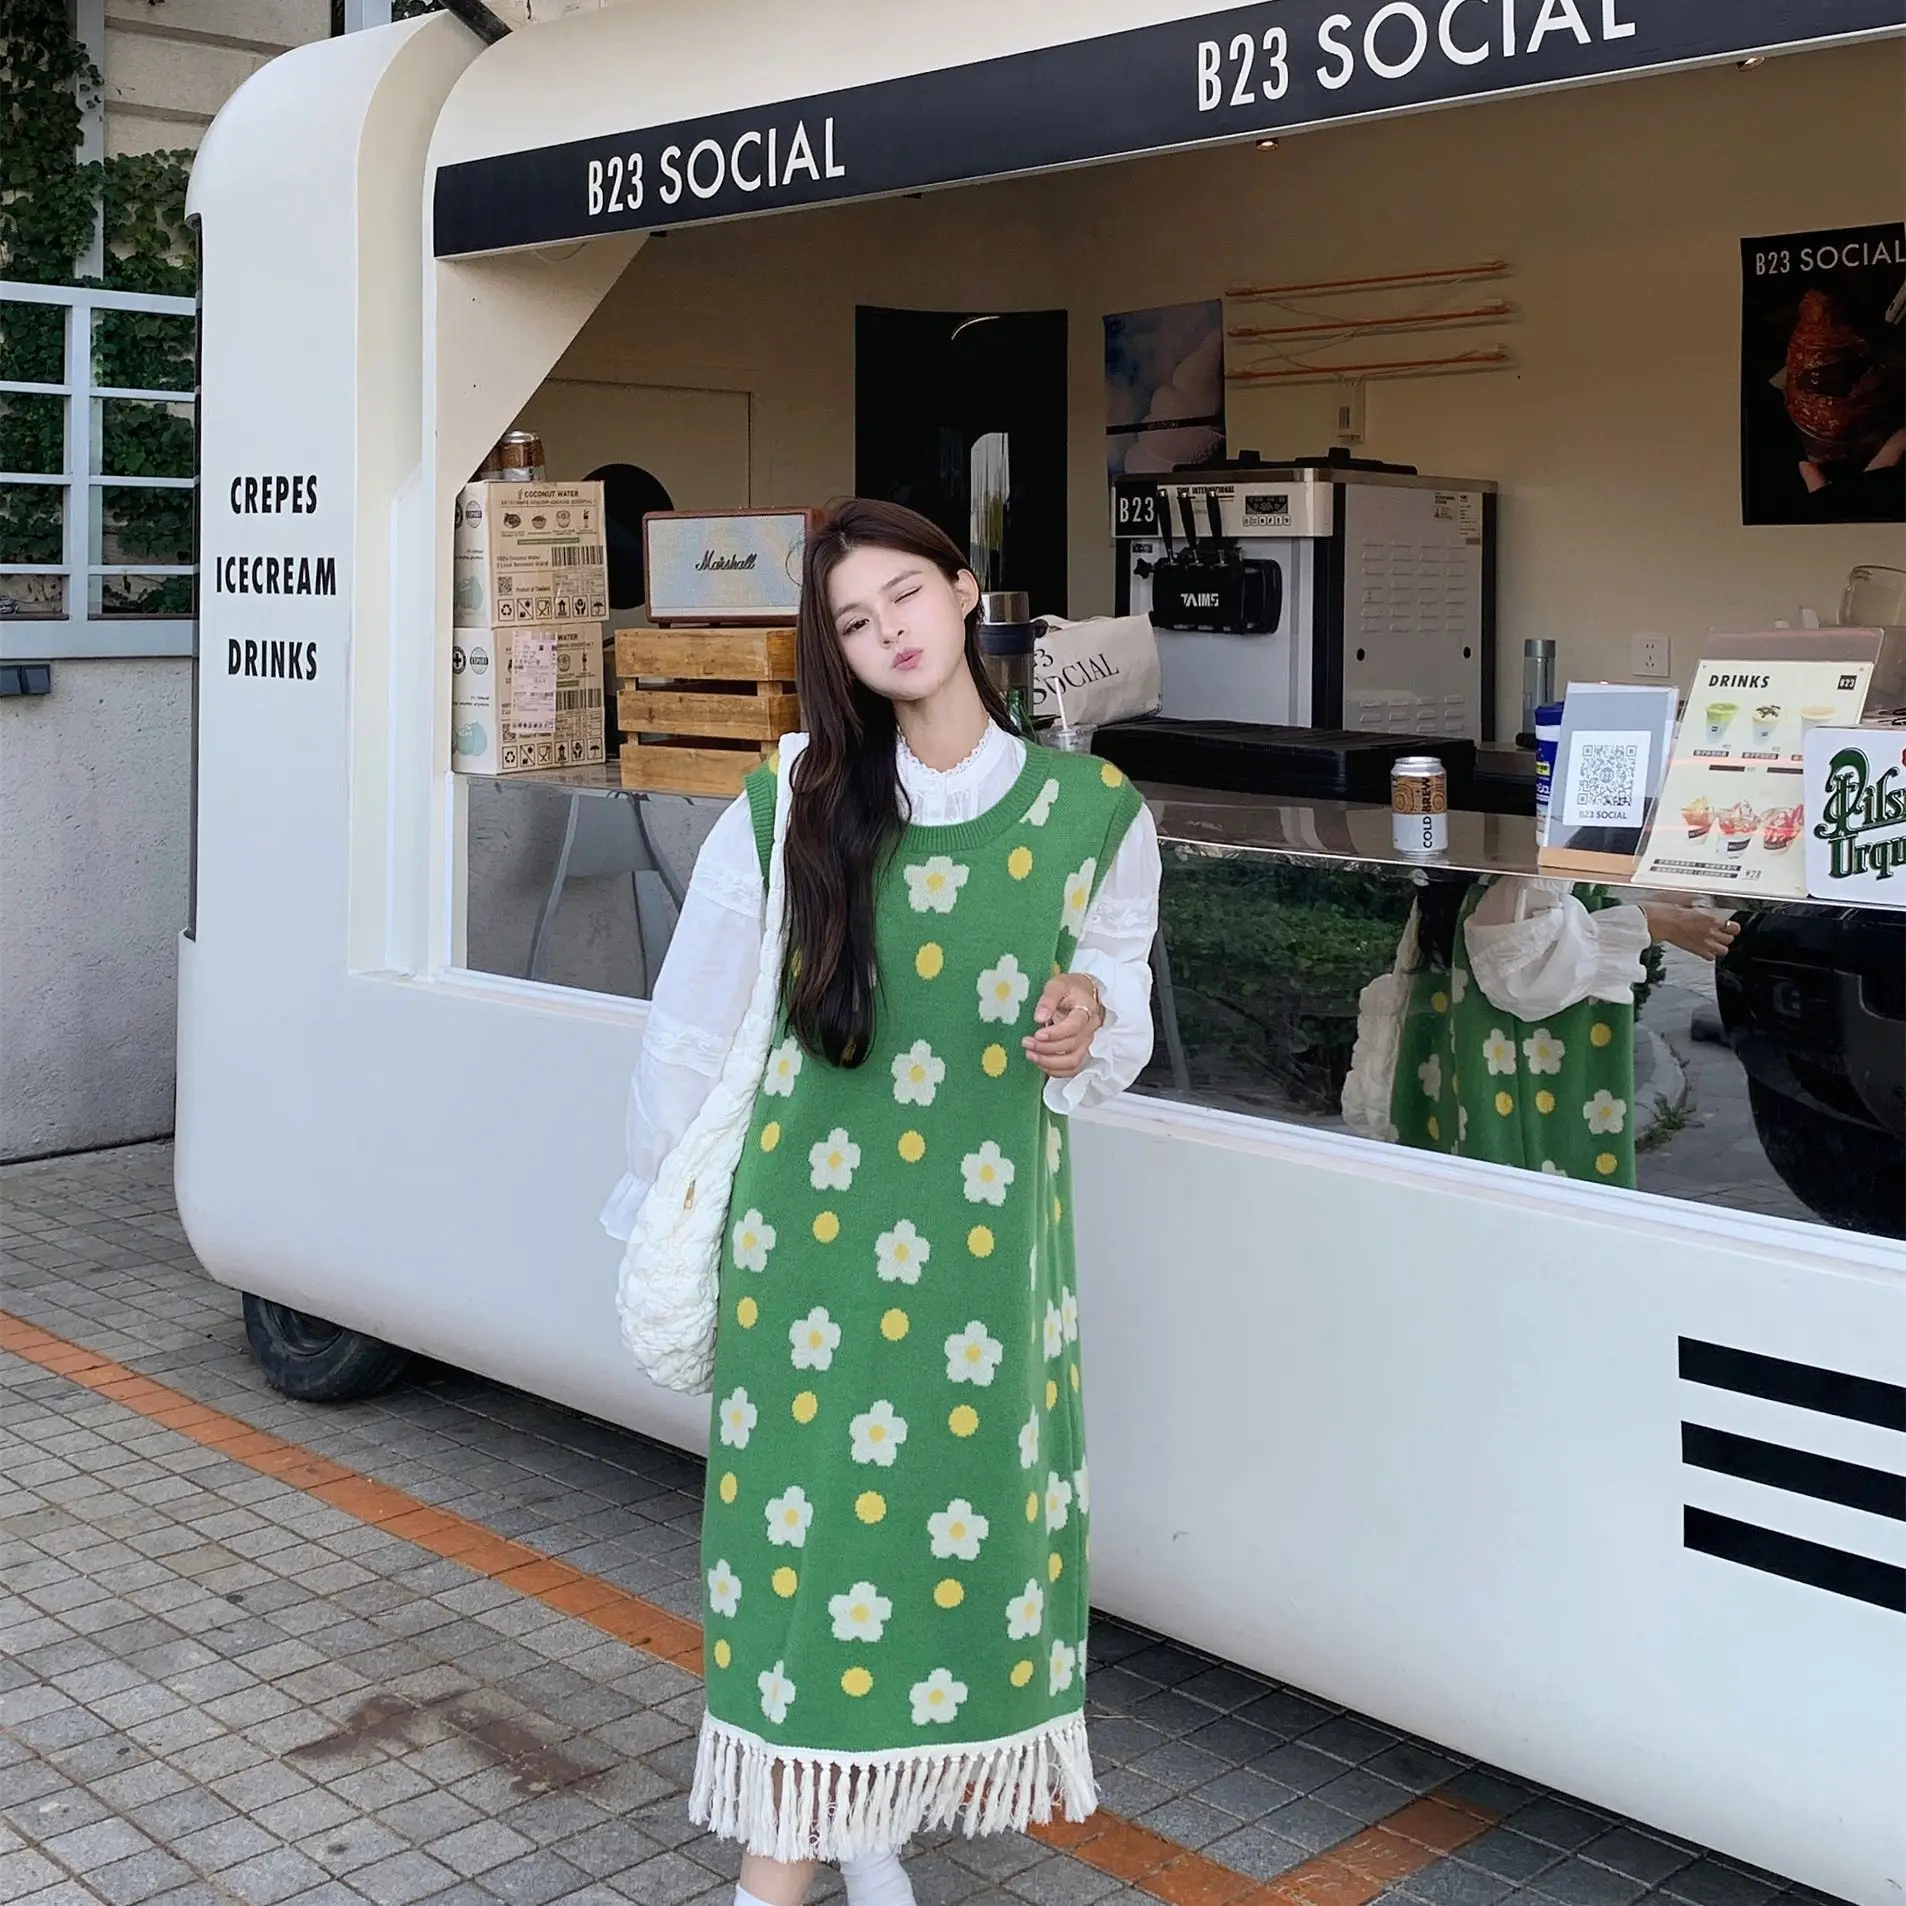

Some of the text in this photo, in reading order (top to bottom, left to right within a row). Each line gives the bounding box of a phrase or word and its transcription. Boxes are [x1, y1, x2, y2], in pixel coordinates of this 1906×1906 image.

[1198, 27, 1289, 112] B23
[588, 117, 845, 216] B23 SOCIAL
[1756, 239, 1906, 276] B23 SOCIAL
[230, 475, 318, 515] CREPES
[524, 490, 555, 498] COCONUT
[1119, 496, 1155, 523] B23
[216, 556, 337, 596] ICECREAM
[695, 550, 758, 571] Marshall
[228, 638, 318, 681] DRINKS
[1708, 675, 1770, 689] DRINKS
[1421, 777, 1432, 848] COLD BREW
[1814, 747, 1906, 839] Pils
[1595, 811, 1628, 819] SOCIAL
